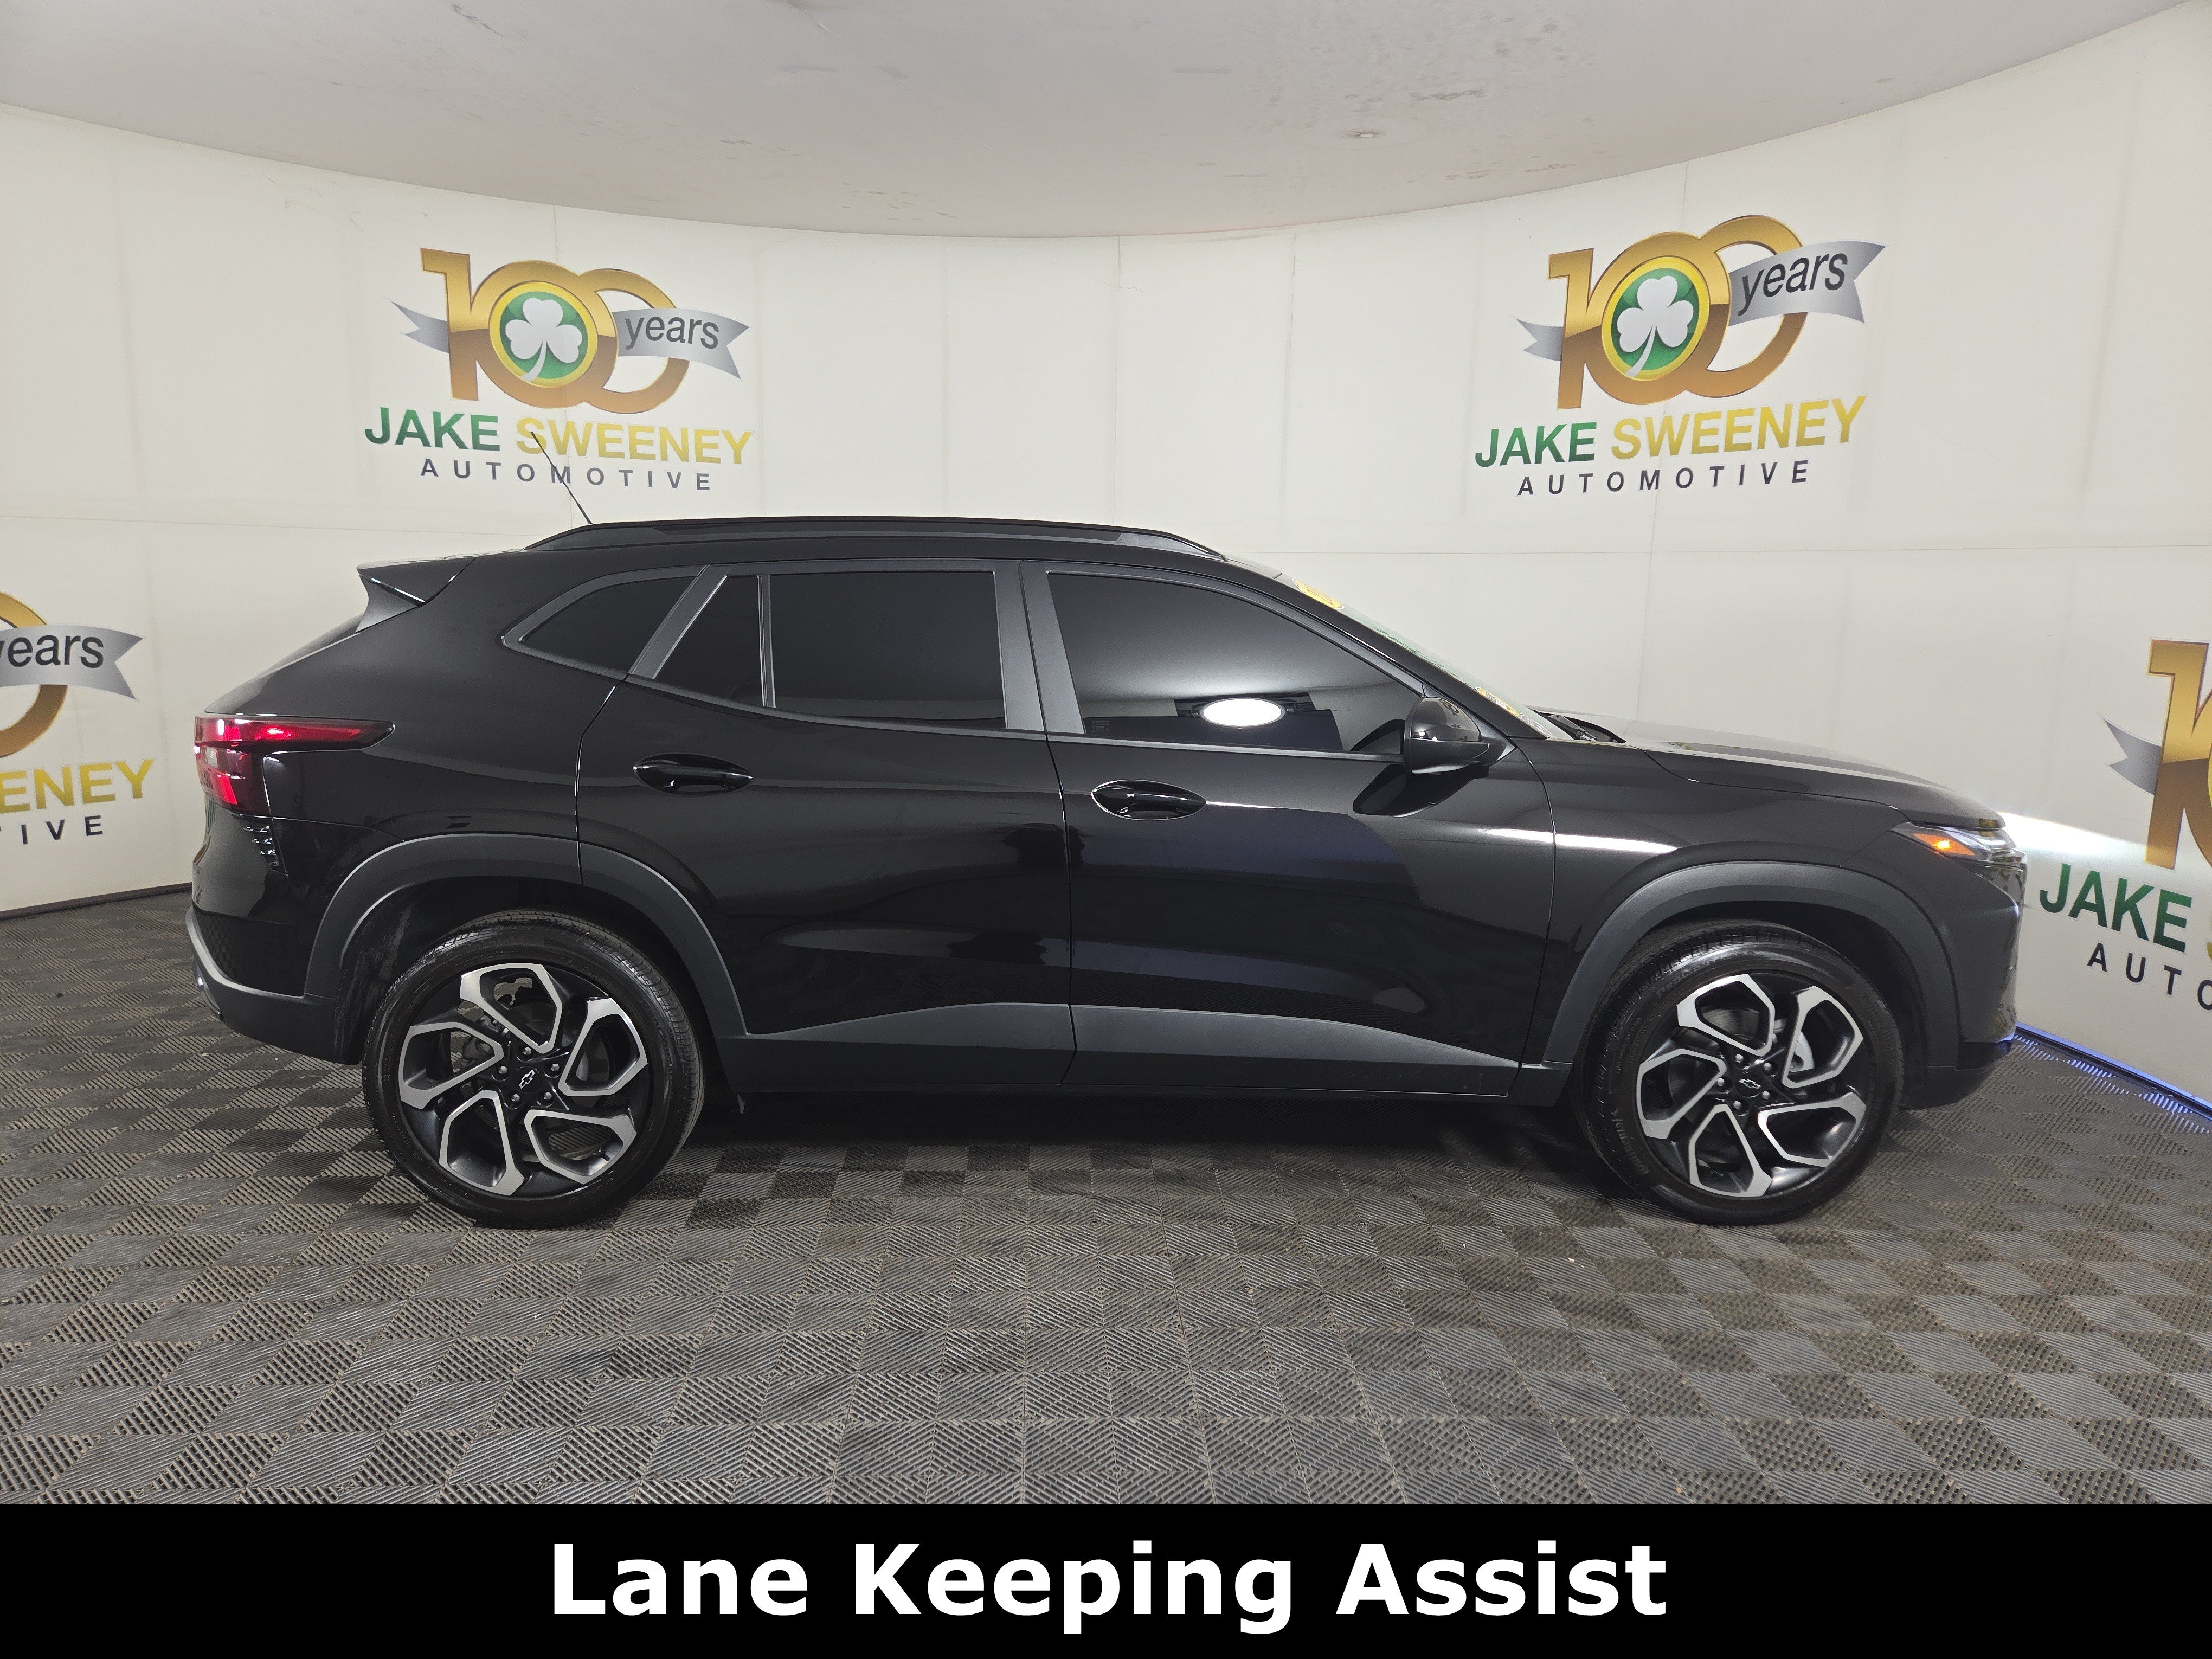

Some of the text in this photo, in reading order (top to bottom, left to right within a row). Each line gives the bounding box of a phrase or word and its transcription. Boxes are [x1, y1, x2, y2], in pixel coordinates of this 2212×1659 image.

[1738, 253, 1848, 316] years
[625, 314, 719, 350] years
[365, 408, 753, 465] JAKE SWEENEY
[1475, 395, 1867, 467] JAKE SWEENEY
[421, 458, 710, 491] AUTOMOTIVE
[1517, 460, 1809, 496] AUTOMOTIVE
[0, 816, 103, 845] IVE
[2040, 864, 2192, 953] JAKE
